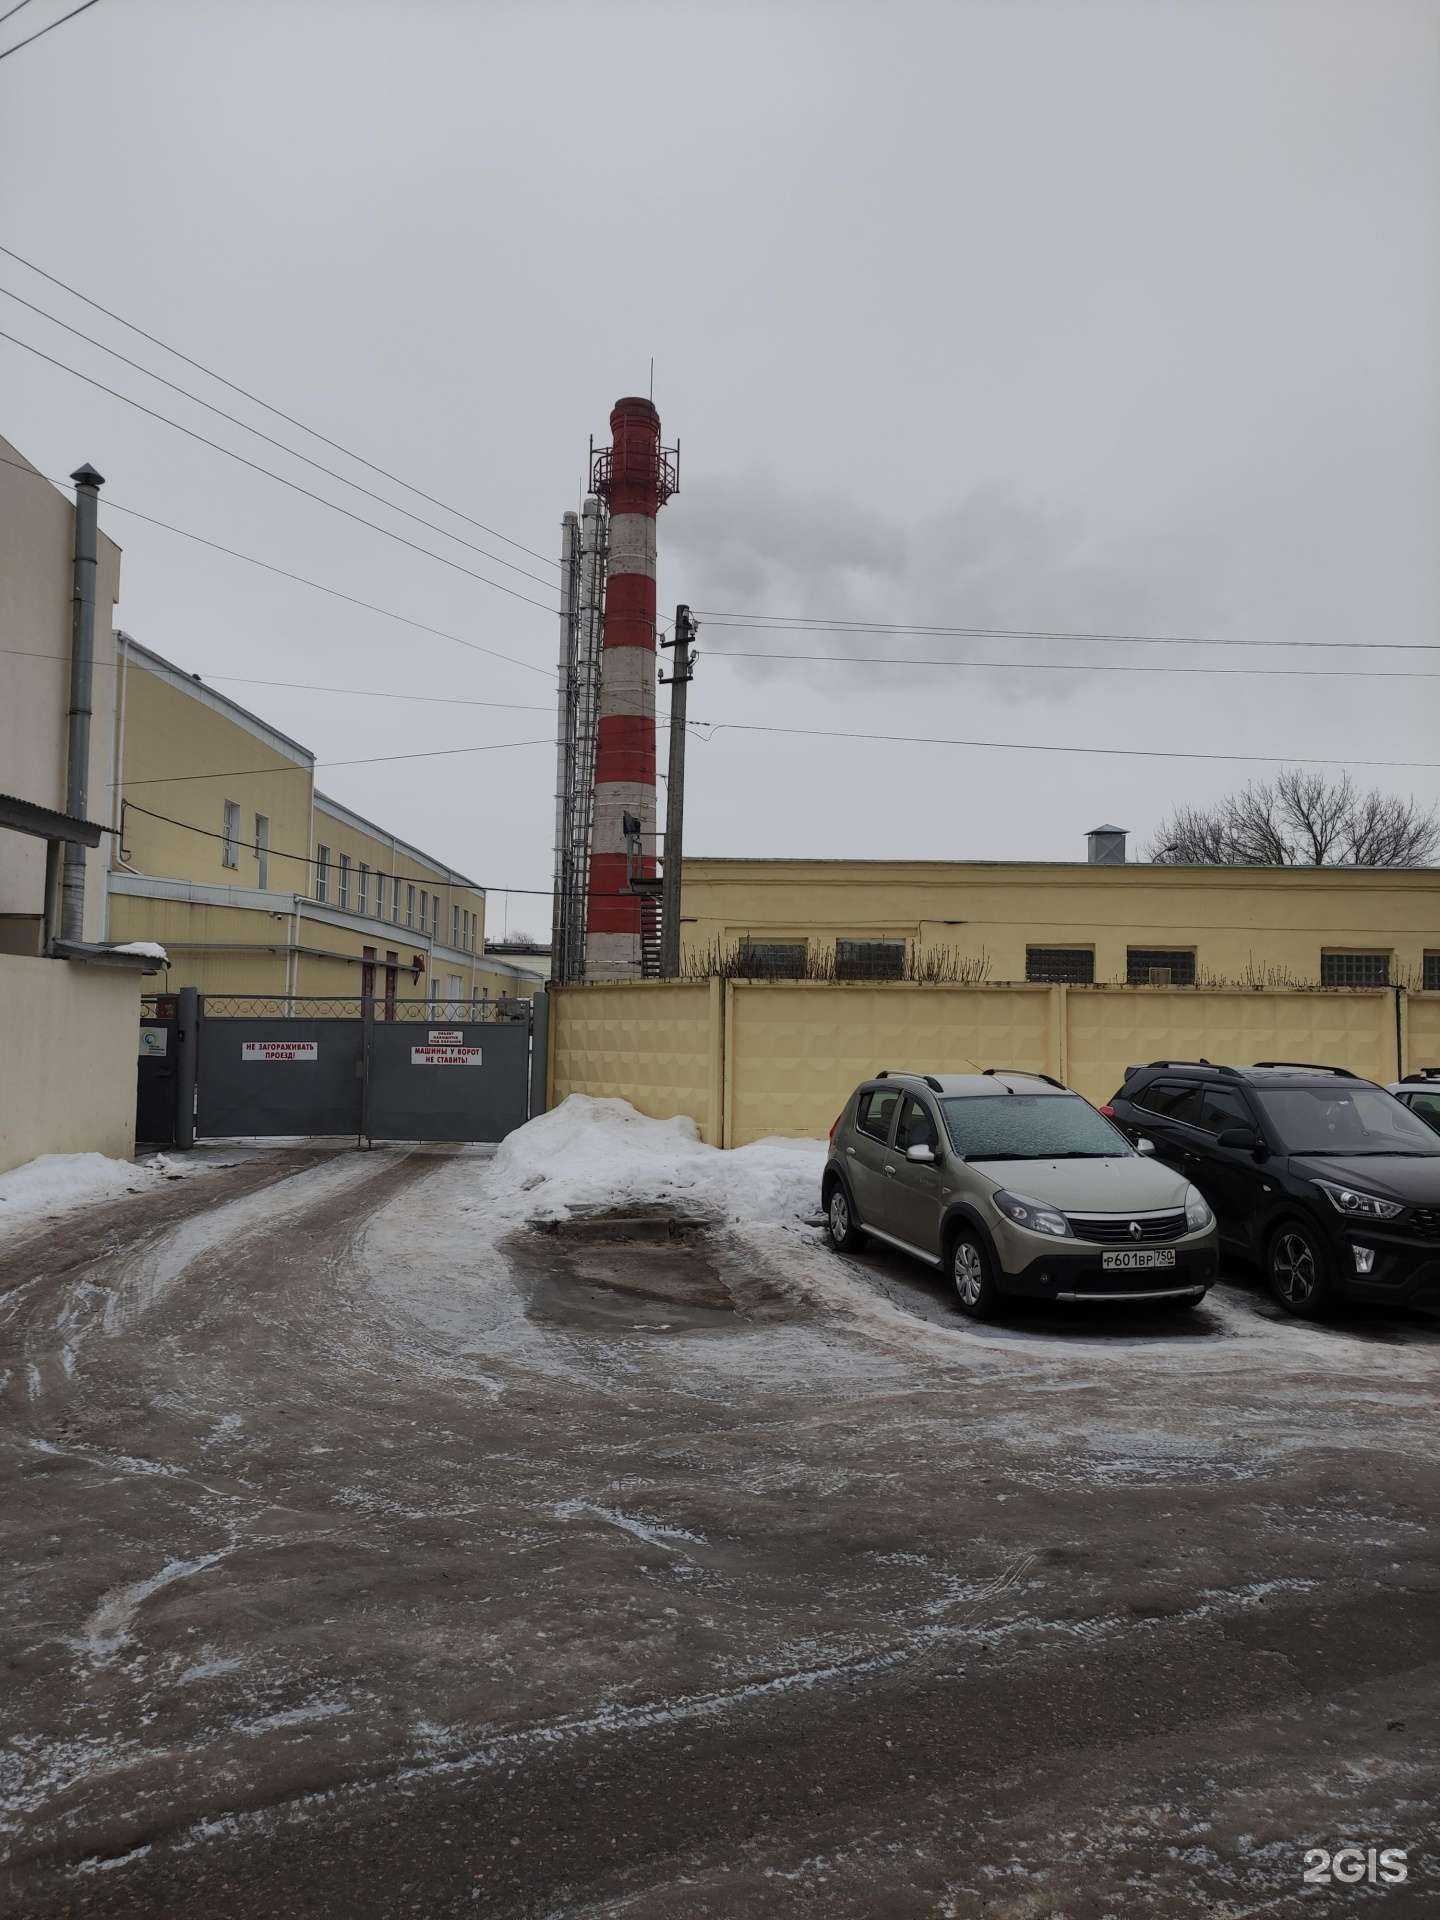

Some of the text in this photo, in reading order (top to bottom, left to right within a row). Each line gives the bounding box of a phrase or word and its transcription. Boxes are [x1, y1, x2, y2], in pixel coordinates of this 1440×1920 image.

[259, 1043, 314, 1051] ЗАГОРАЖИВАТЬ
[265, 1051, 296, 1059] ПРОЕЗД!
[414, 1047, 448, 1055] МАШИНЫ
[457, 1048, 480, 1056] ВОРОТ
[437, 1056, 468, 1064] СТАВИТЬ!
